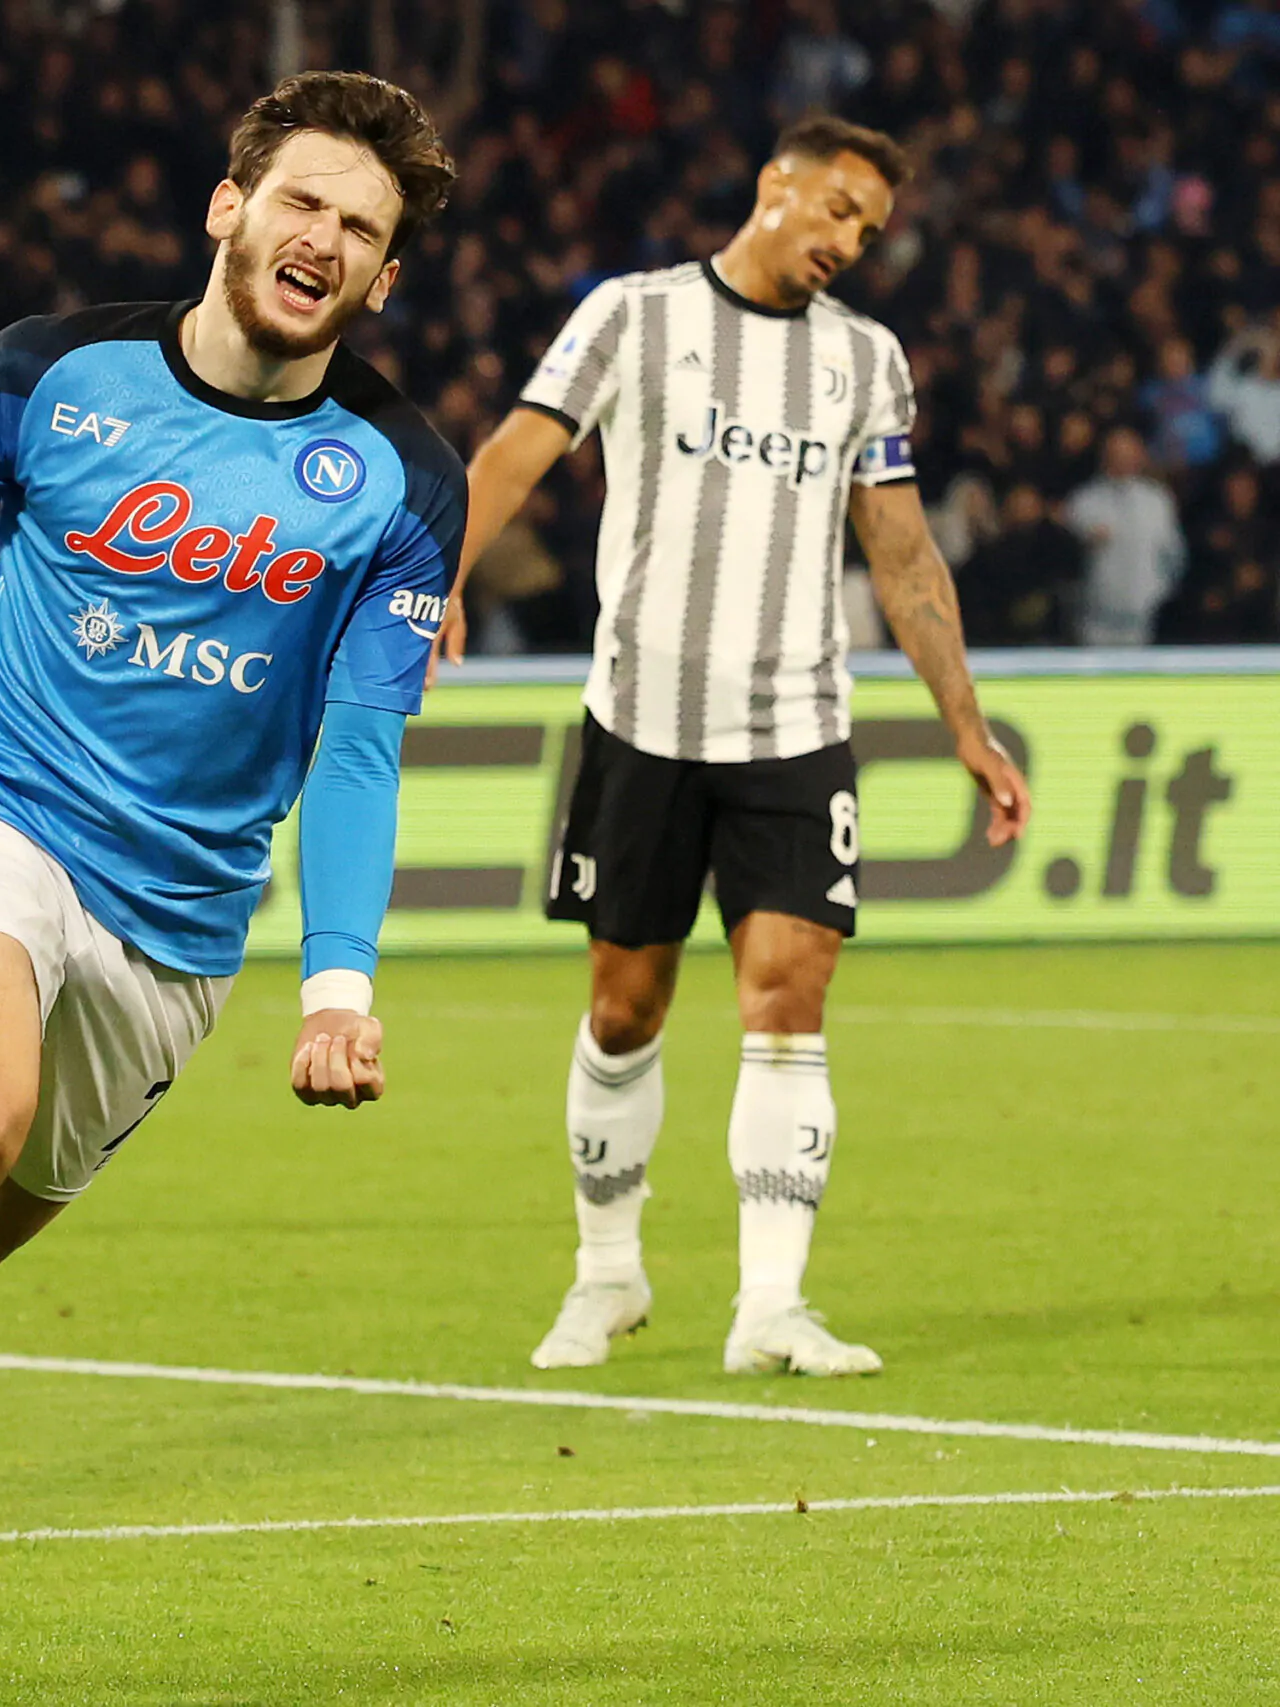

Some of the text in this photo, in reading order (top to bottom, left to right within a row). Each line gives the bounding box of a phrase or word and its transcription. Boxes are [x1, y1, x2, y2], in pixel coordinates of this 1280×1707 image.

[48, 402, 132, 448] EA7
[676, 406, 830, 484] Jeep
[311, 455, 349, 489] N
[64, 480, 326, 605] Lete
[127, 622, 273, 694] MSC
